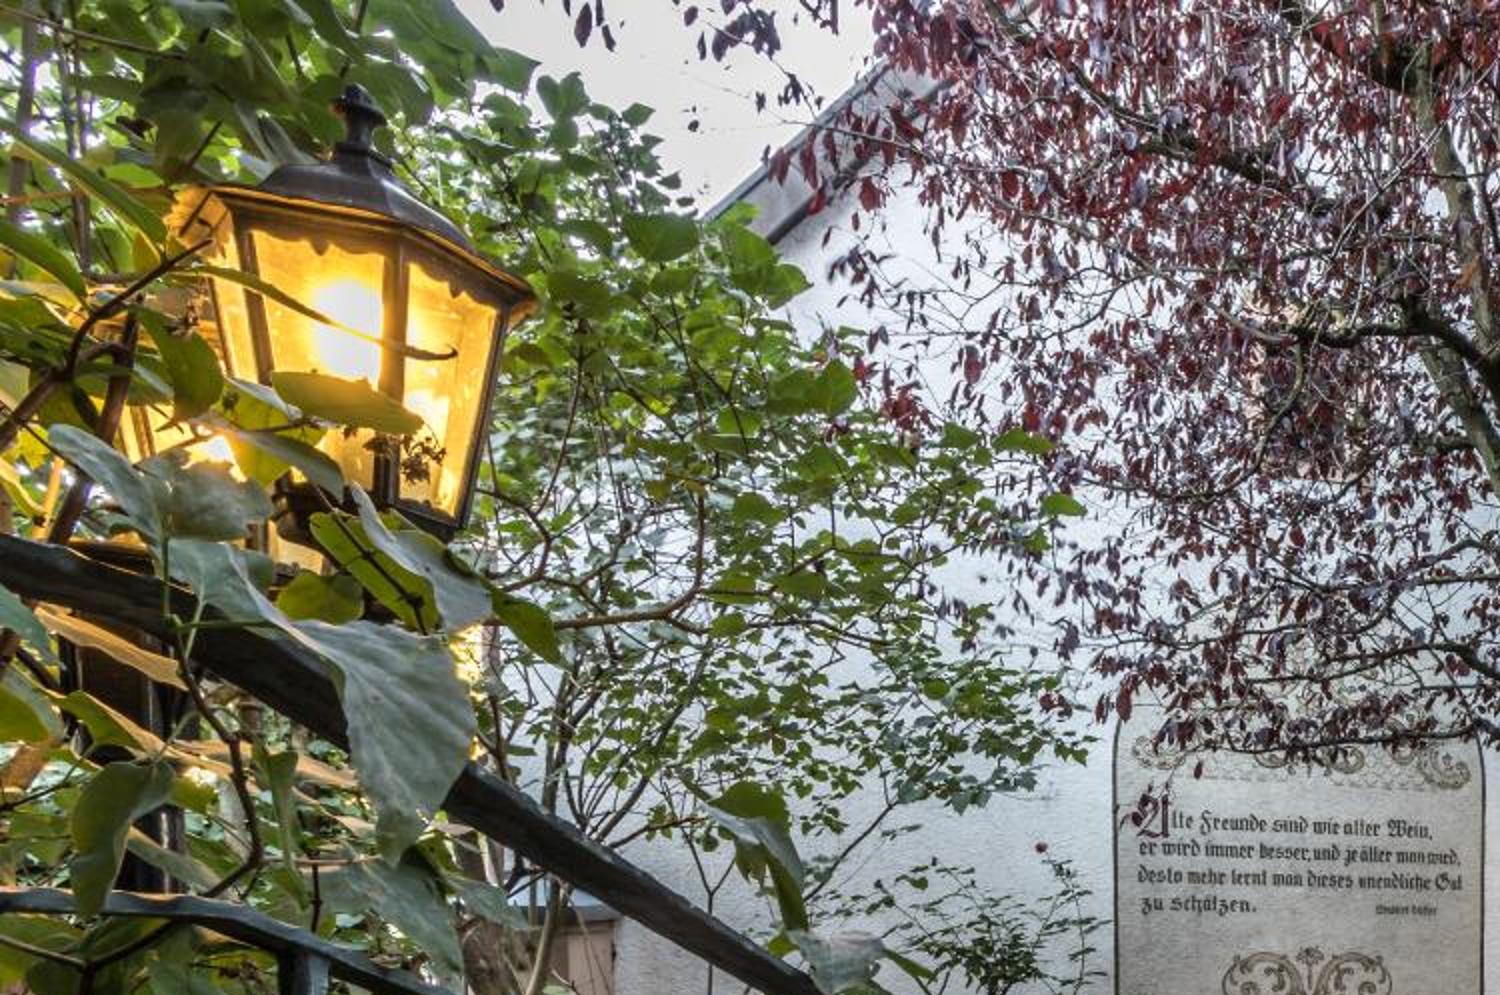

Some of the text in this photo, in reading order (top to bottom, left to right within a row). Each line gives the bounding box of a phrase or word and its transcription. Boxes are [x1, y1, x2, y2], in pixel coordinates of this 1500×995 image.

[1132, 793, 1433, 840] Alte Freunde sind wie alter Wein,
[1139, 841, 1157, 856] er
[1161, 838, 1201, 857] wird
[1205, 841, 1255, 859] immer
[1259, 842, 1312, 862] besser,
[1314, 844, 1341, 861] und
[1344, 845, 1358, 867] je
[1395, 850, 1425, 864] man
[1138, 864, 1183, 885] desto
[1187, 868, 1227, 887] mehr
[1231, 869, 1267, 886] lernt
[1271, 871, 1303, 886] man
[1307, 869, 1354, 889] dieses
[1358, 871, 1432, 892] unendliche
[1140, 897, 1164, 916] zu
